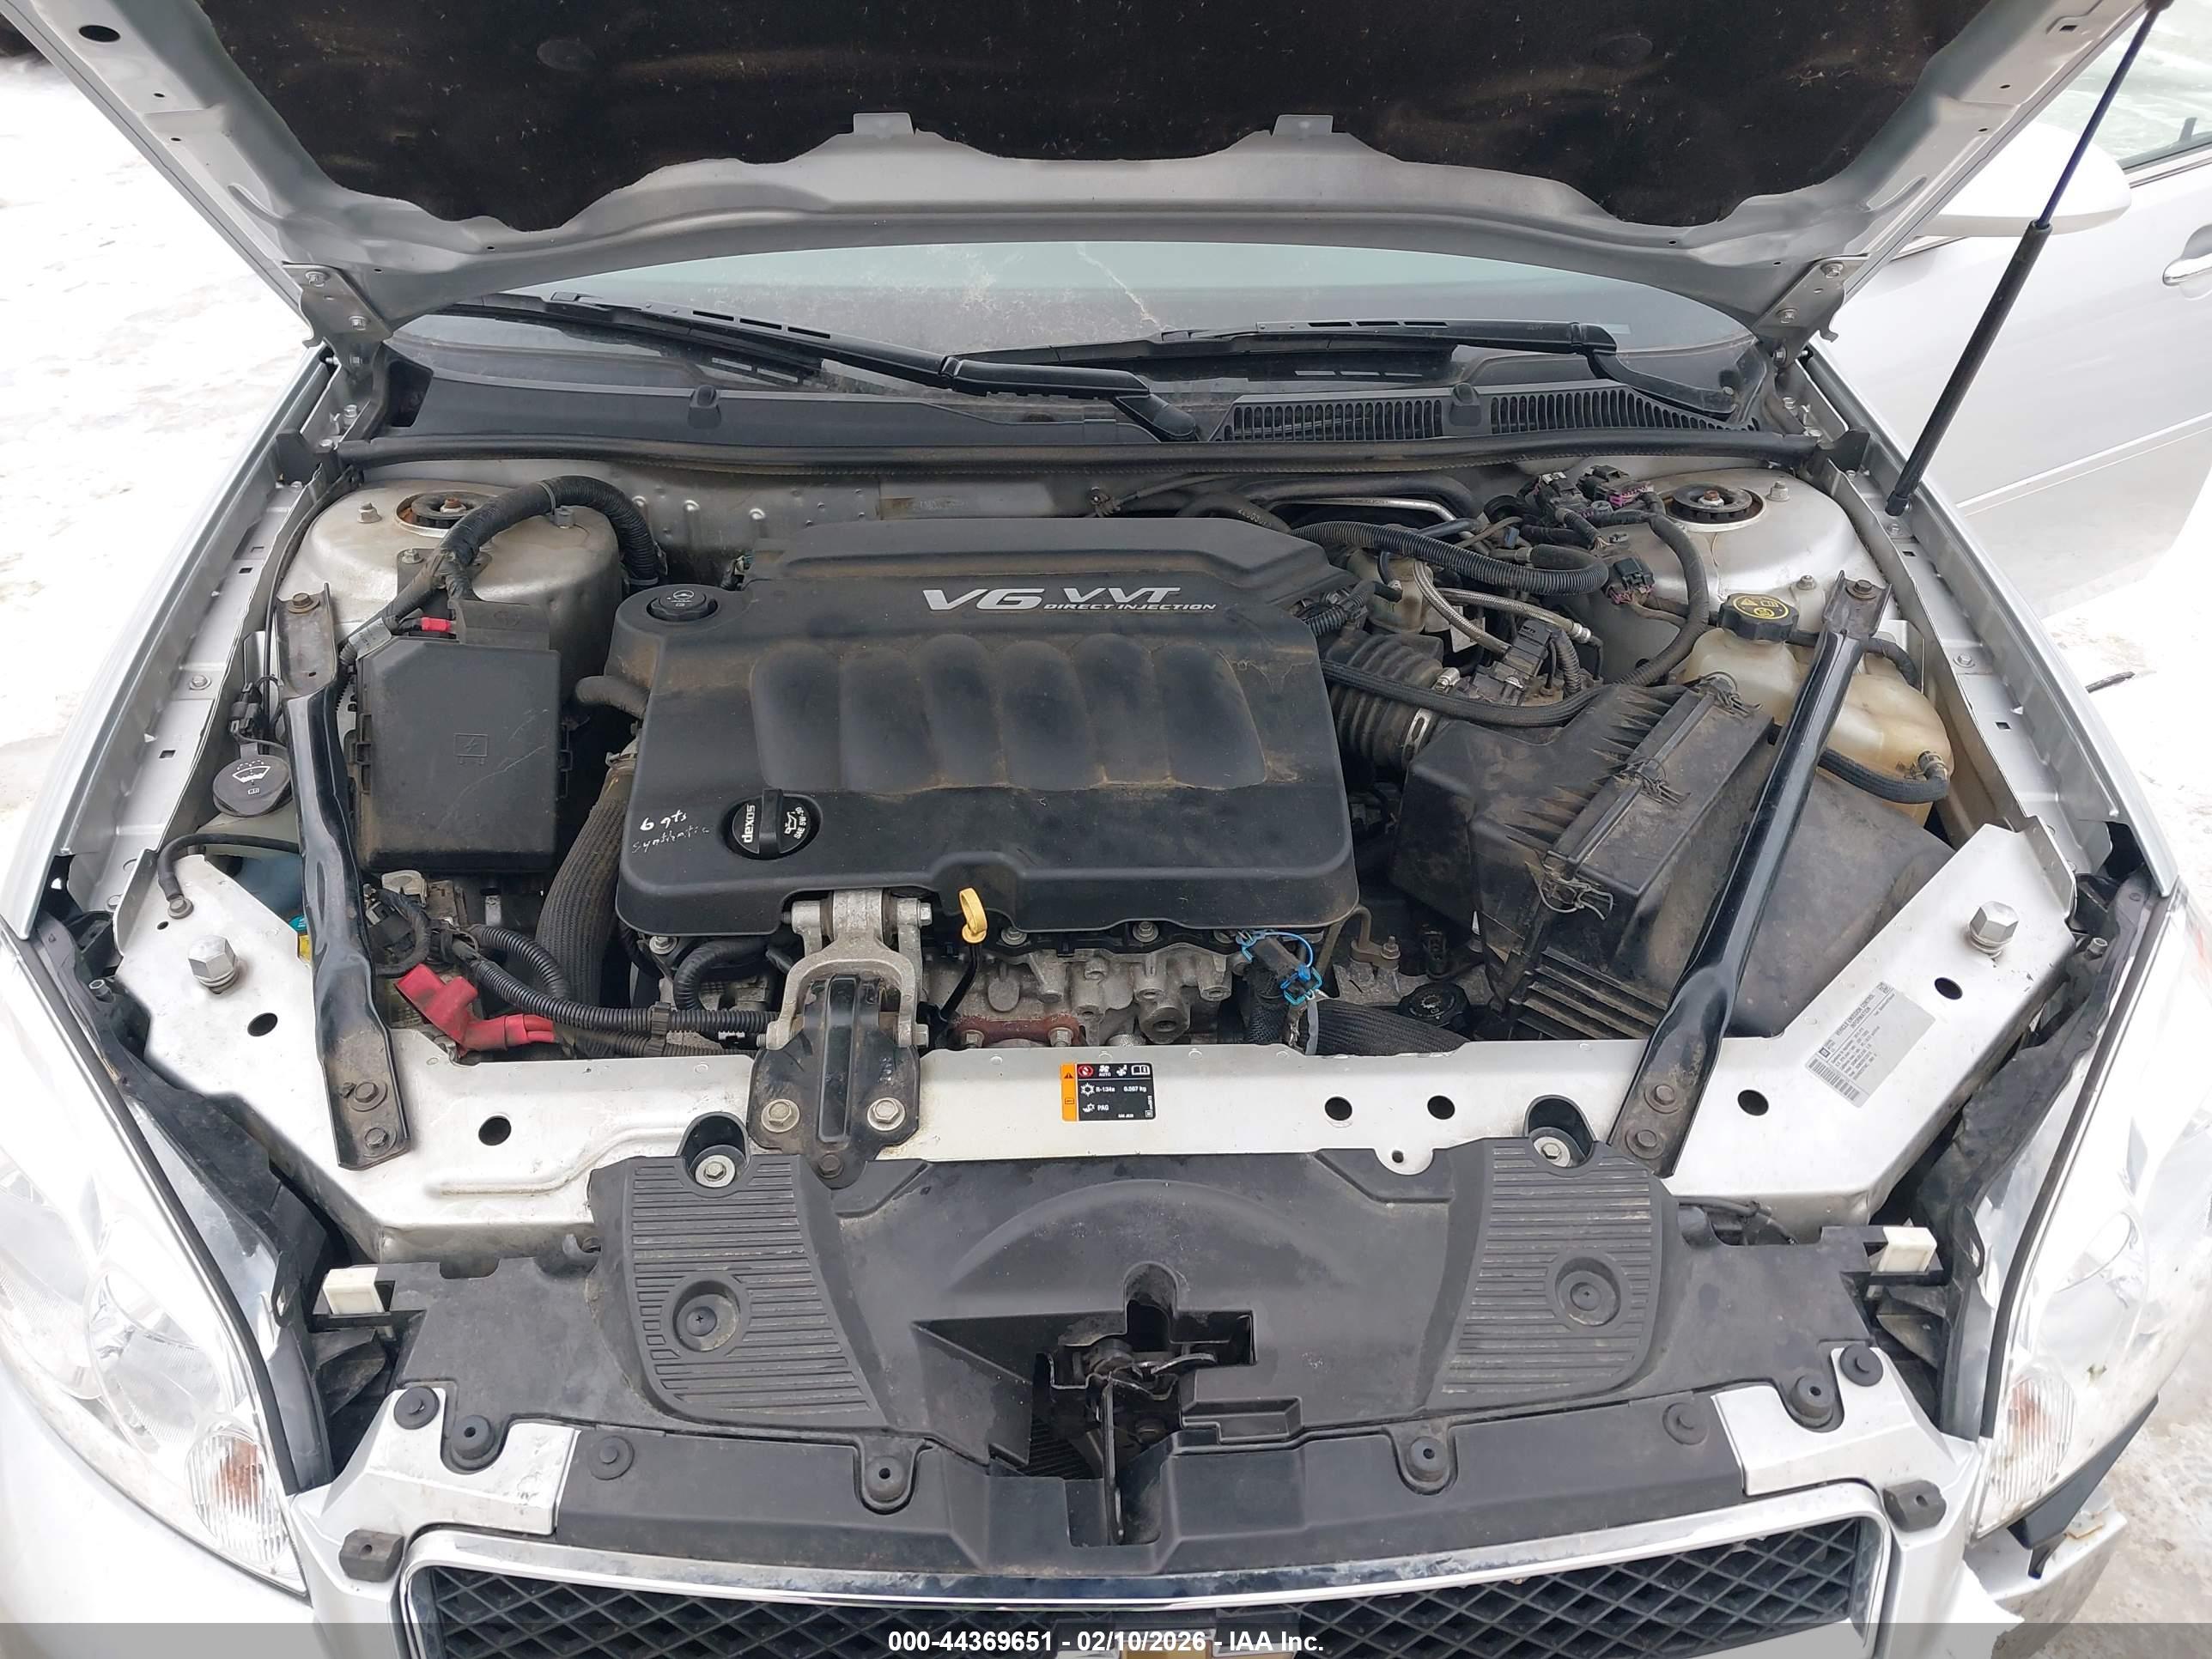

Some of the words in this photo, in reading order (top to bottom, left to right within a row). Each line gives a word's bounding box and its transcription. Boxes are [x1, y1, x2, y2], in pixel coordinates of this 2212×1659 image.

[922, 587, 1045, 611] V6
[1062, 587, 1182, 603] VVT
[640, 817, 654, 831] 6
[740, 805, 756, 844] dexos
[795, 805, 807, 828] 5W-30
[793, 828, 806, 841] SAE
